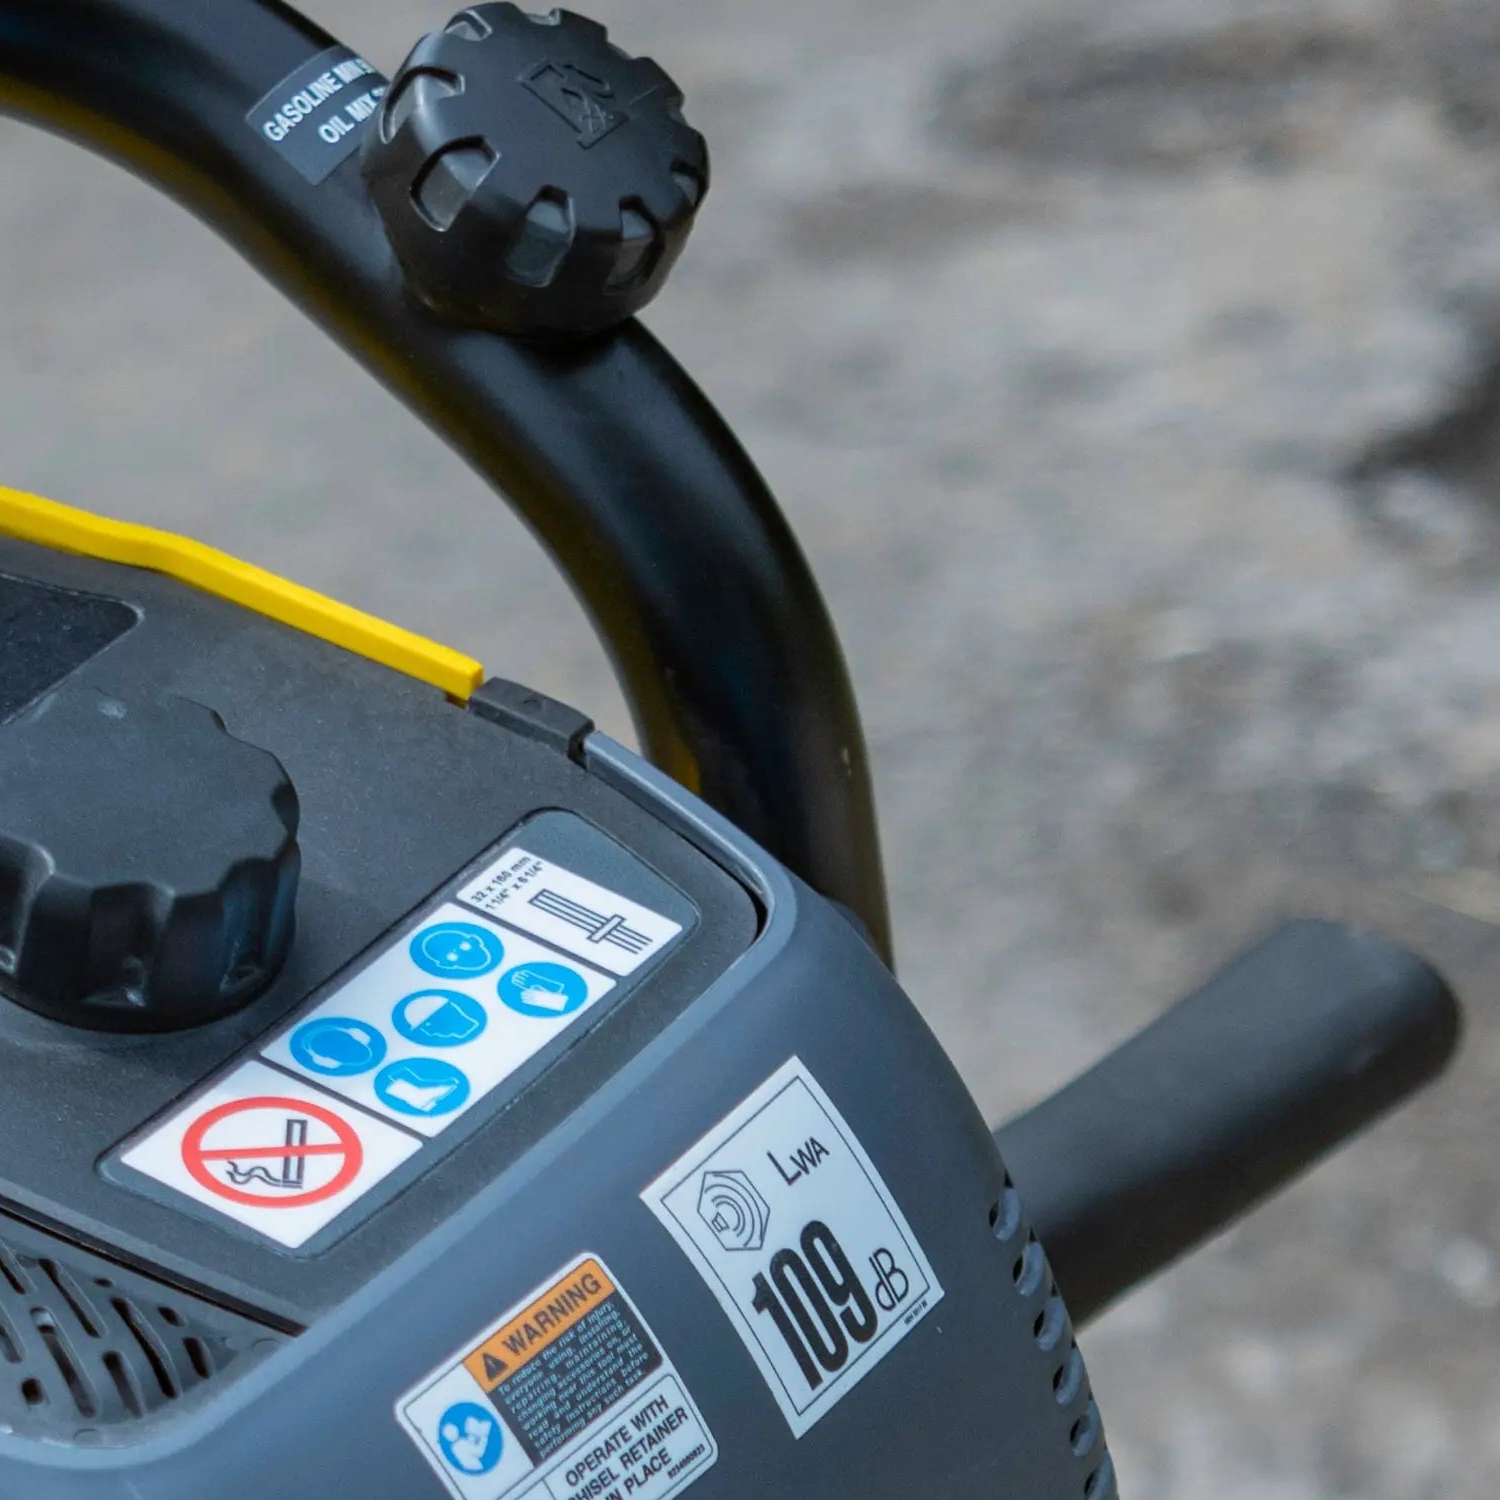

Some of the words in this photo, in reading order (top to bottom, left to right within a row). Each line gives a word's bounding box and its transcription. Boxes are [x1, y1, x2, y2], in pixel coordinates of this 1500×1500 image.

[262, 72, 343, 141] GASOLINE
[318, 115, 355, 143] OIL
[511, 857, 531, 872] mm
[752, 1219, 879, 1390] 109
[868, 1248, 909, 1311] dB
[503, 1272, 602, 1357] WARNING
[511, 1357, 542, 1385] reduce
[541, 1344, 558, 1361] the
[557, 1329, 576, 1348] risk
[574, 1320, 587, 1333] of
[552, 1400, 572, 1420] and
[627, 1341, 643, 1357] the
[578, 1366, 596, 1384] this
[615, 1333, 637, 1354] must
[586, 1402, 604, 1420] any
[602, 1384, 624, 1404] such
[563, 1424, 633, 1489] OPERATE
[629, 1393, 669, 1433] WITH
[618, 1405, 689, 1471] RETAINER
[622, 1446, 672, 1495] PLACE
